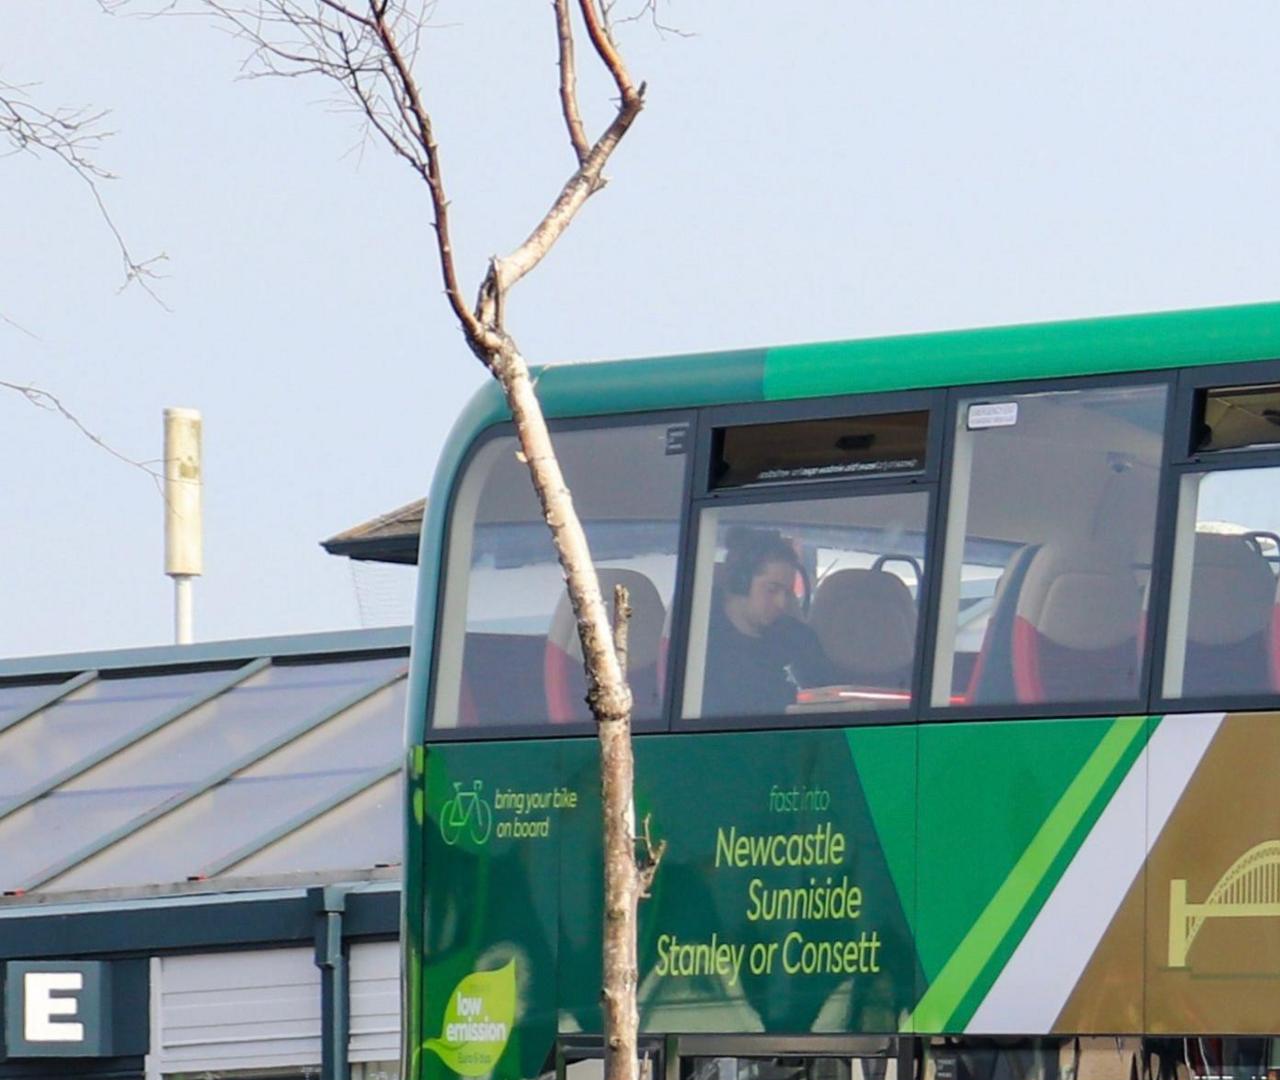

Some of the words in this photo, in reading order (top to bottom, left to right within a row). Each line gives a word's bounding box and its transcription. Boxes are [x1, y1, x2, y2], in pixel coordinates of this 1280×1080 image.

[495, 788, 524, 814] bring
[525, 791, 552, 814] your
[553, 787, 577, 808] bike
[769, 785, 799, 812] fast
[800, 786, 830, 811] into
[497, 821, 511, 838] on
[513, 816, 550, 838] board
[715, 822, 845, 868] Newcastle
[746, 876, 862, 921] Sunniside
[656, 932, 745, 986] Stanley
[750, 942, 778, 975] or
[782, 931, 881, 974] Consett
[23, 971, 85, 1042] E
[457, 991, 482, 1016] low
[446, 1016, 506, 1042] emission
